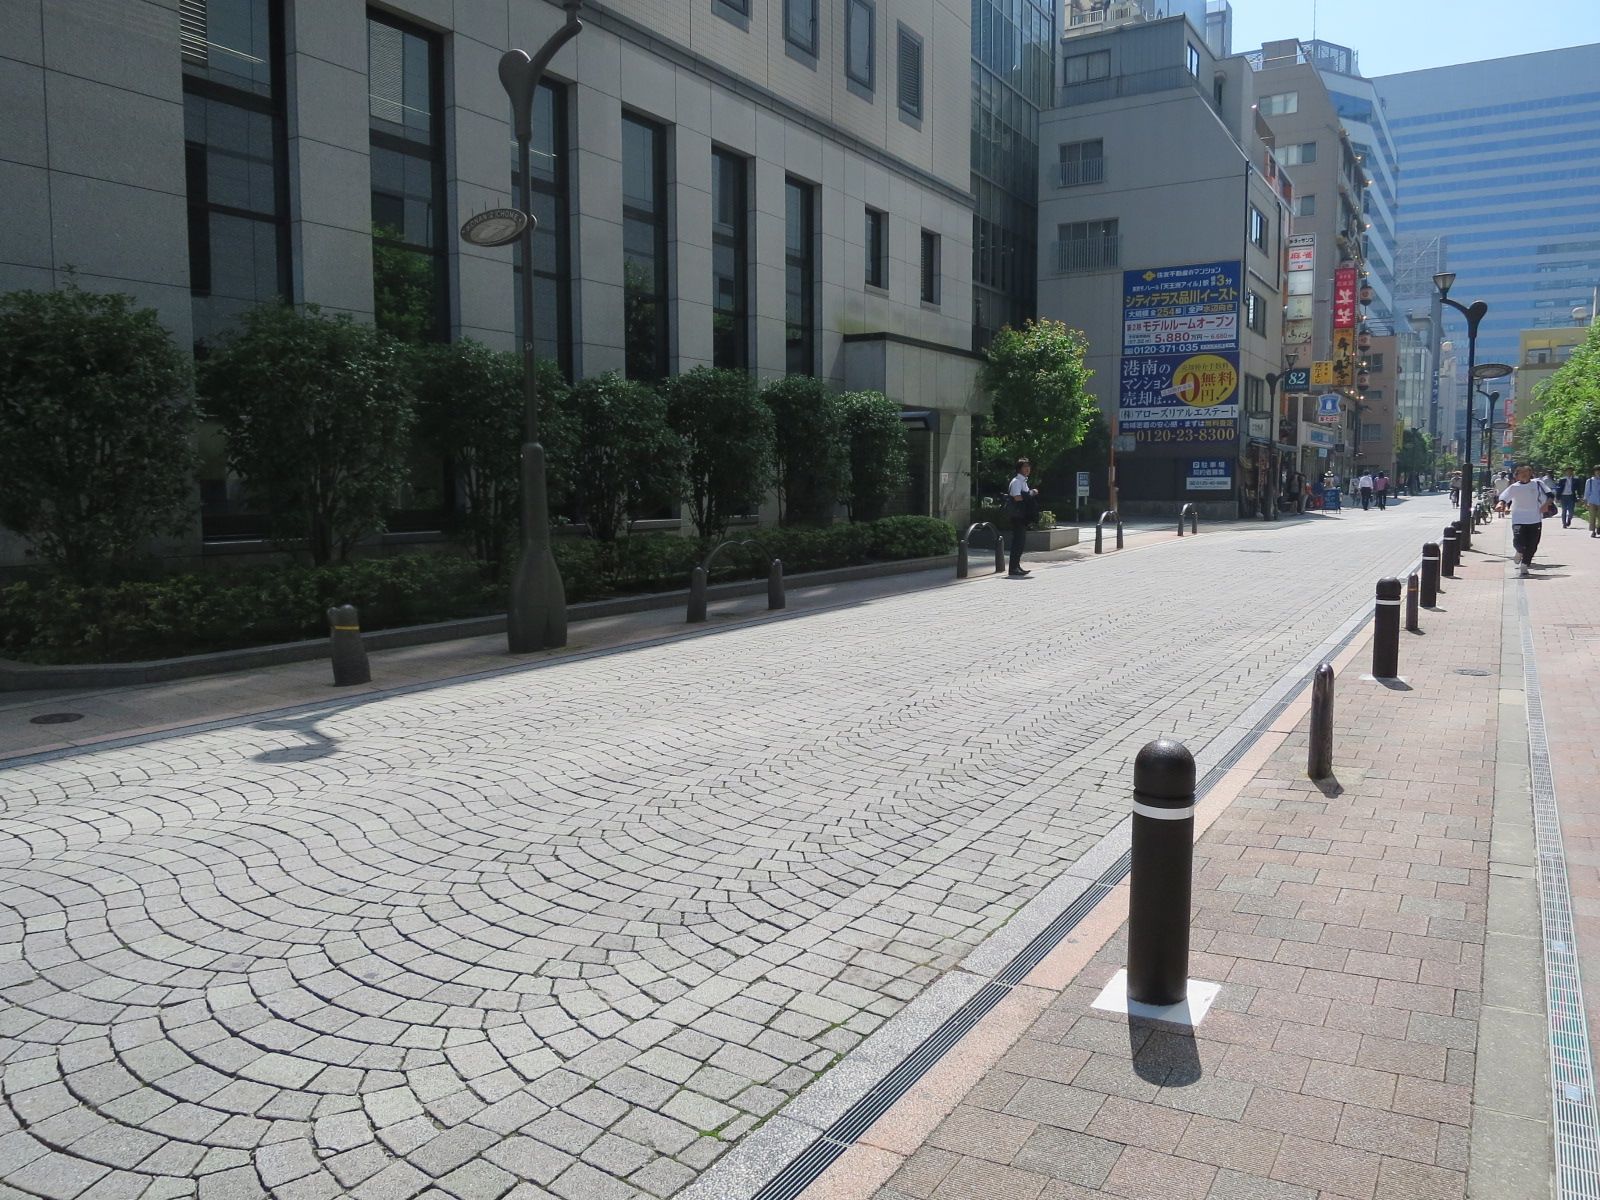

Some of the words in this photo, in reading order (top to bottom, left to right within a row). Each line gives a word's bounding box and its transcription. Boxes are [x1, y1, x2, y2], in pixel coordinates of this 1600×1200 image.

[1126, 287, 1237, 307] シティテラス品川イースト
[1123, 359, 1171, 377] 港南の
[1122, 376, 1172, 391] マンション
[1288, 372, 1306, 385] 82
[1136, 427, 1235, 442] 0120-23-8300
